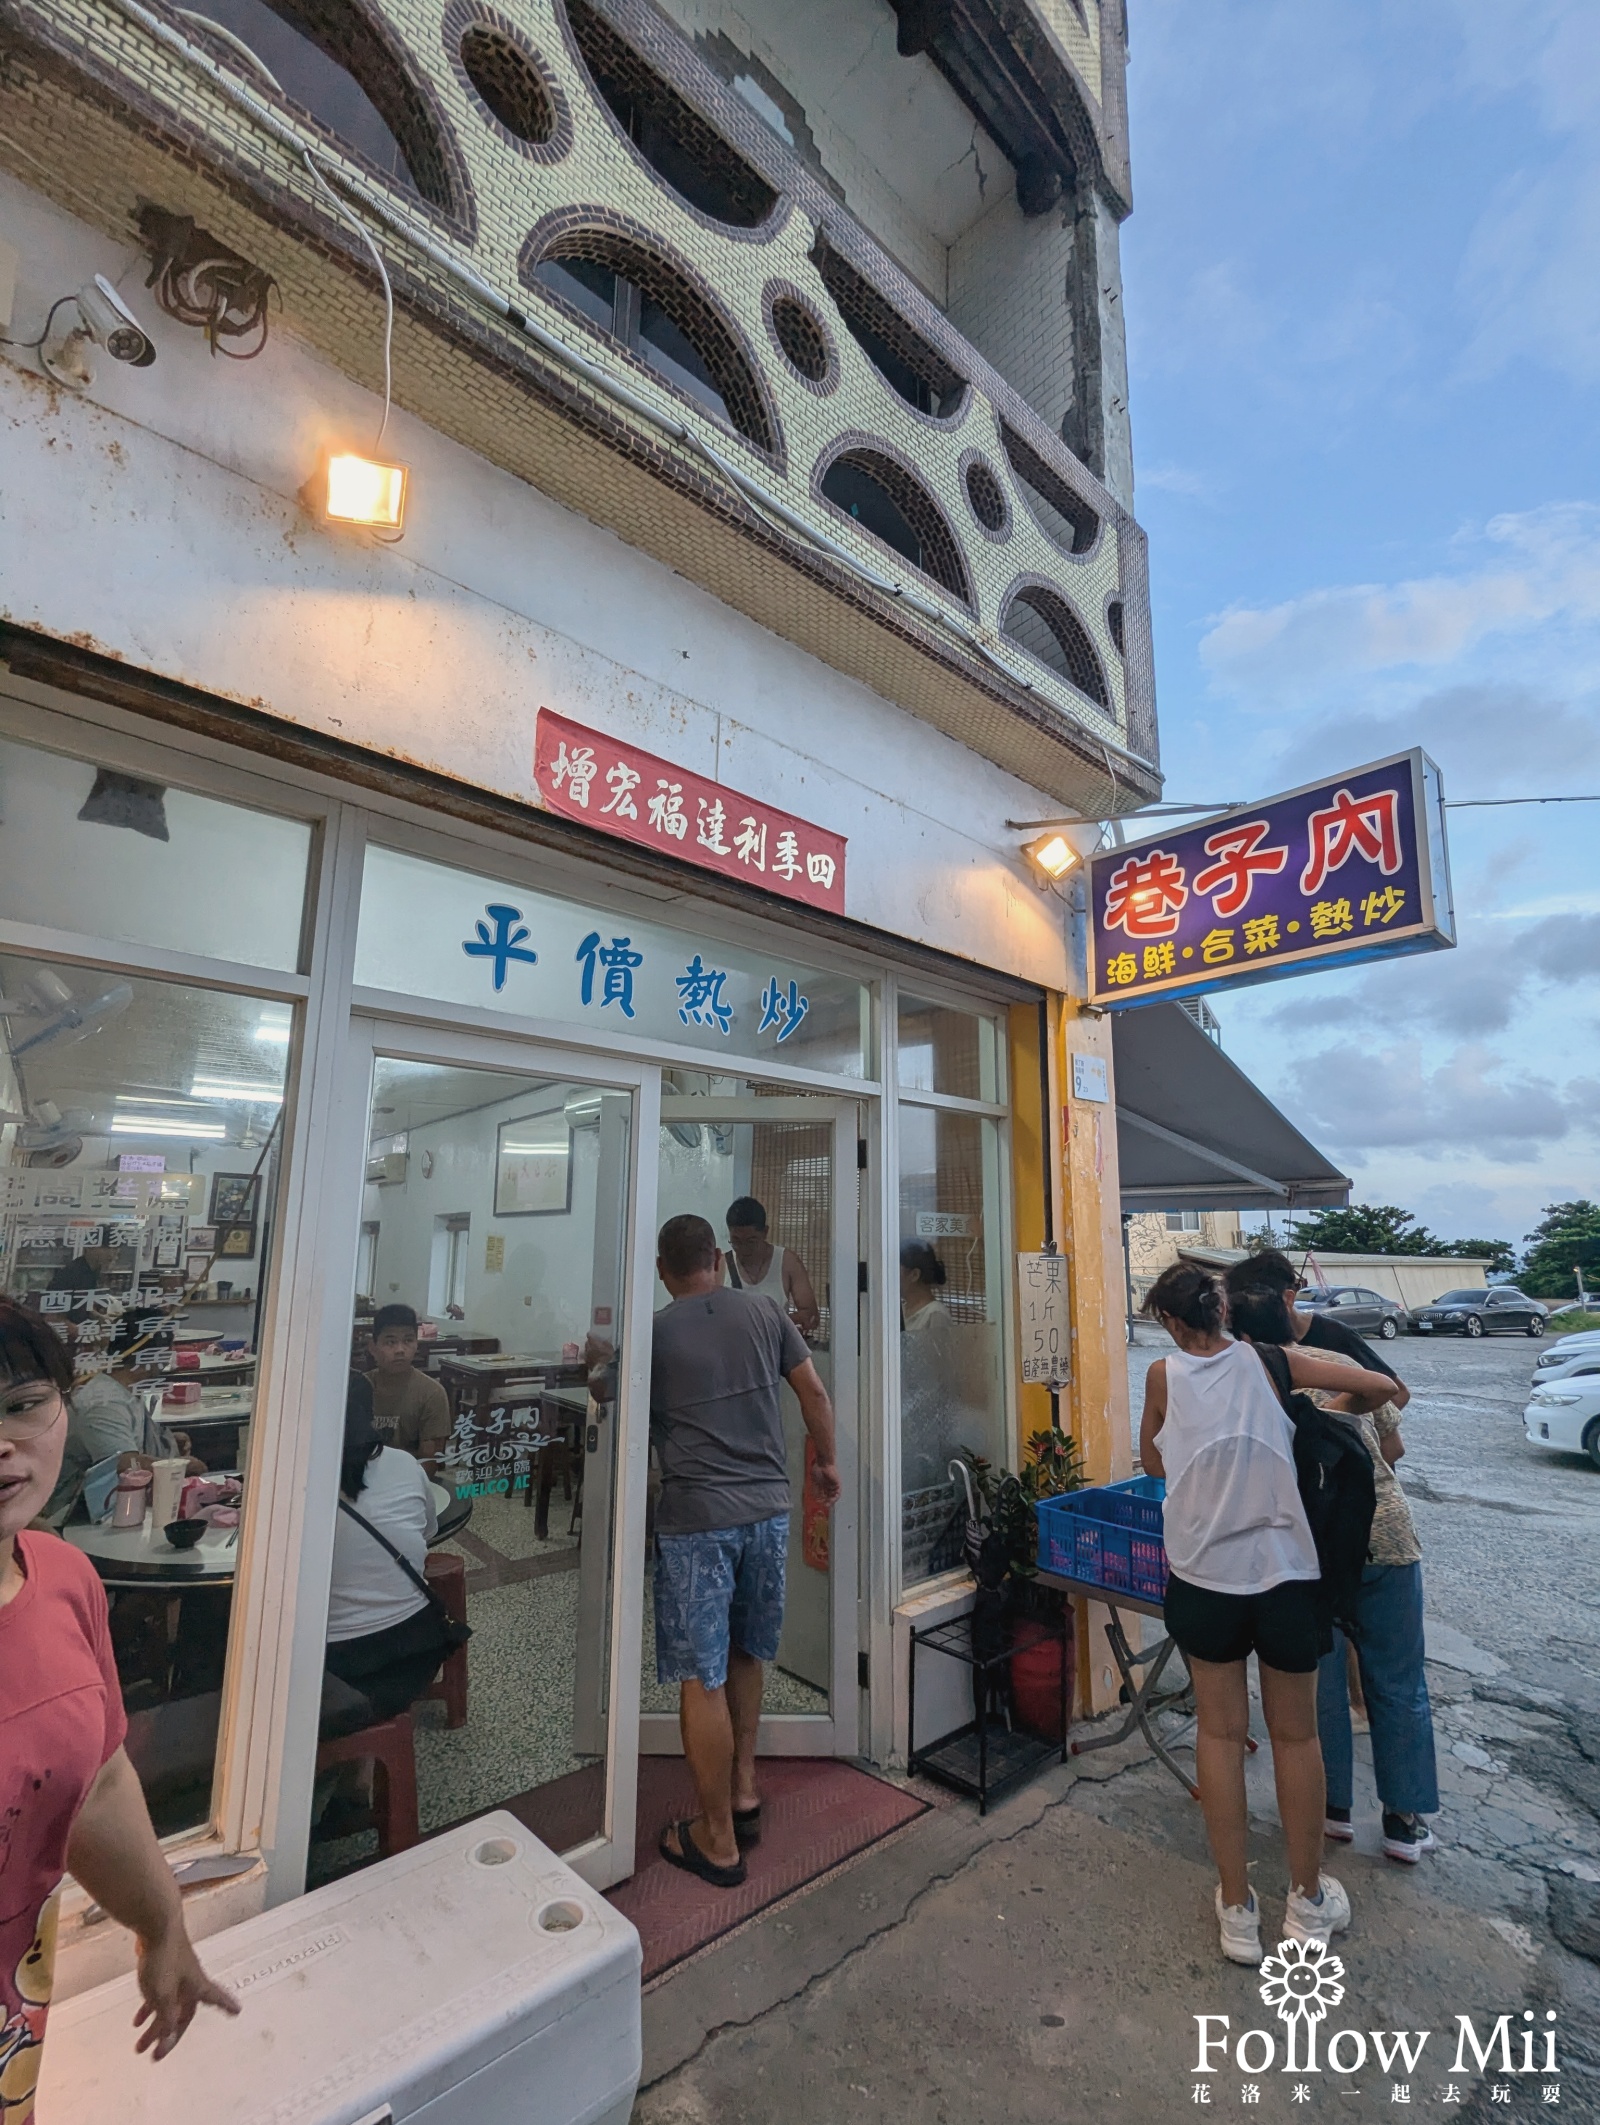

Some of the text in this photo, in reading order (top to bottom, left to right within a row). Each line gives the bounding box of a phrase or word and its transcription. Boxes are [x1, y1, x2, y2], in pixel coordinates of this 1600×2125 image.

[461, 902, 810, 1043] 平價熱炒
[1026, 1260, 1062, 1294] 芒果
[1034, 1327, 1059, 1354] 50
[455, 1459, 531, 1485] 歡迎光臨
